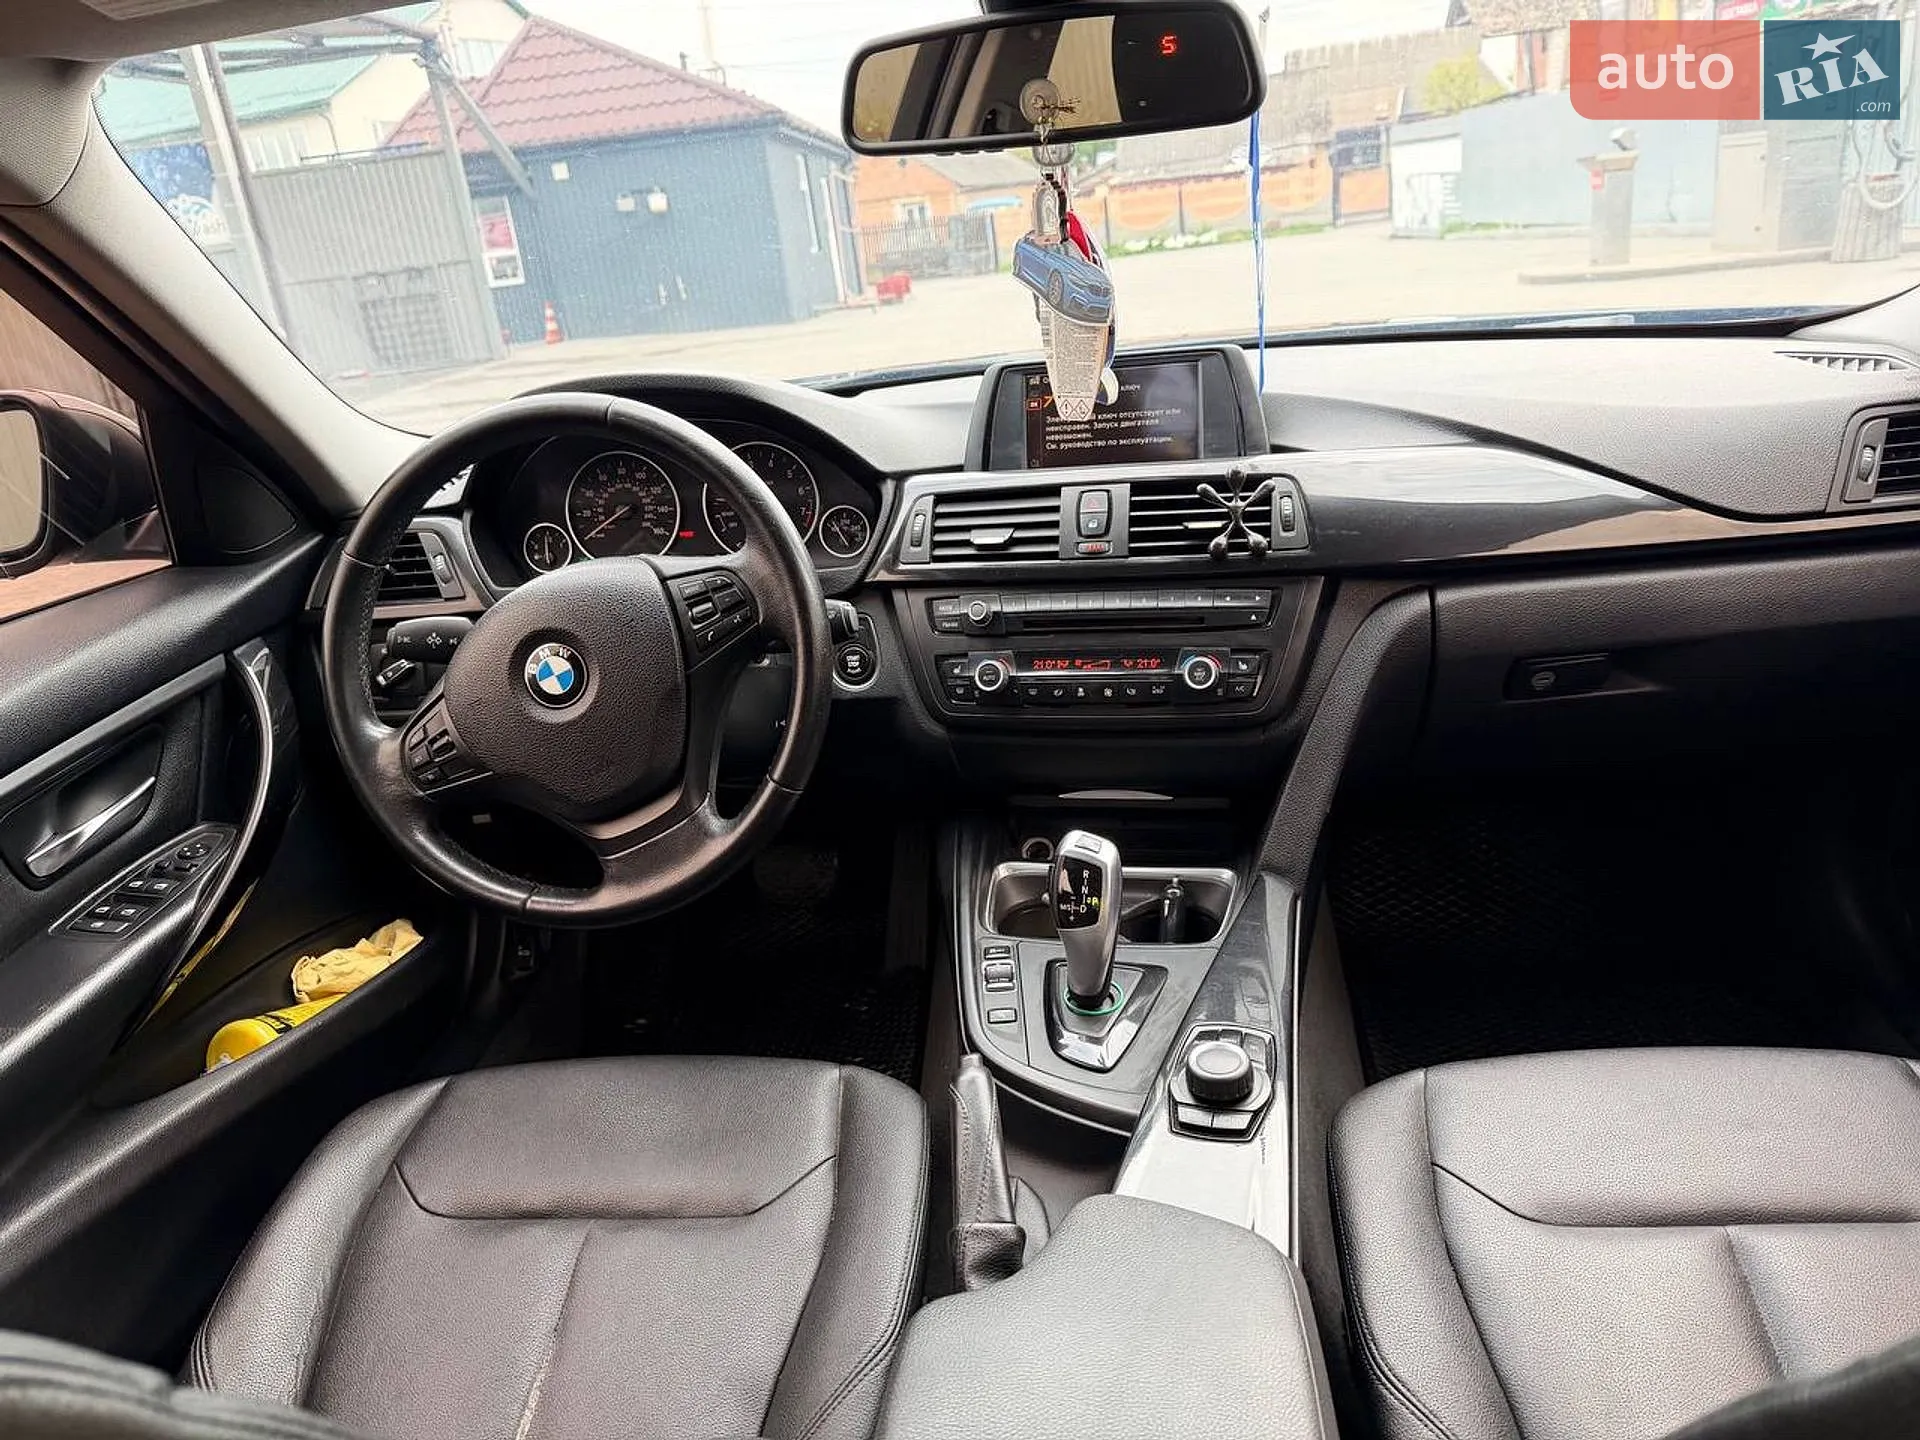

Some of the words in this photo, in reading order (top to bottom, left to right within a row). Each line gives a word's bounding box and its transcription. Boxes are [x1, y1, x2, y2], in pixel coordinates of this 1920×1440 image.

[528, 646, 572, 675] BMW
[1083, 869, 1090, 879] R
[1081, 885, 1089, 894] N
[1080, 904, 1088, 913] D
